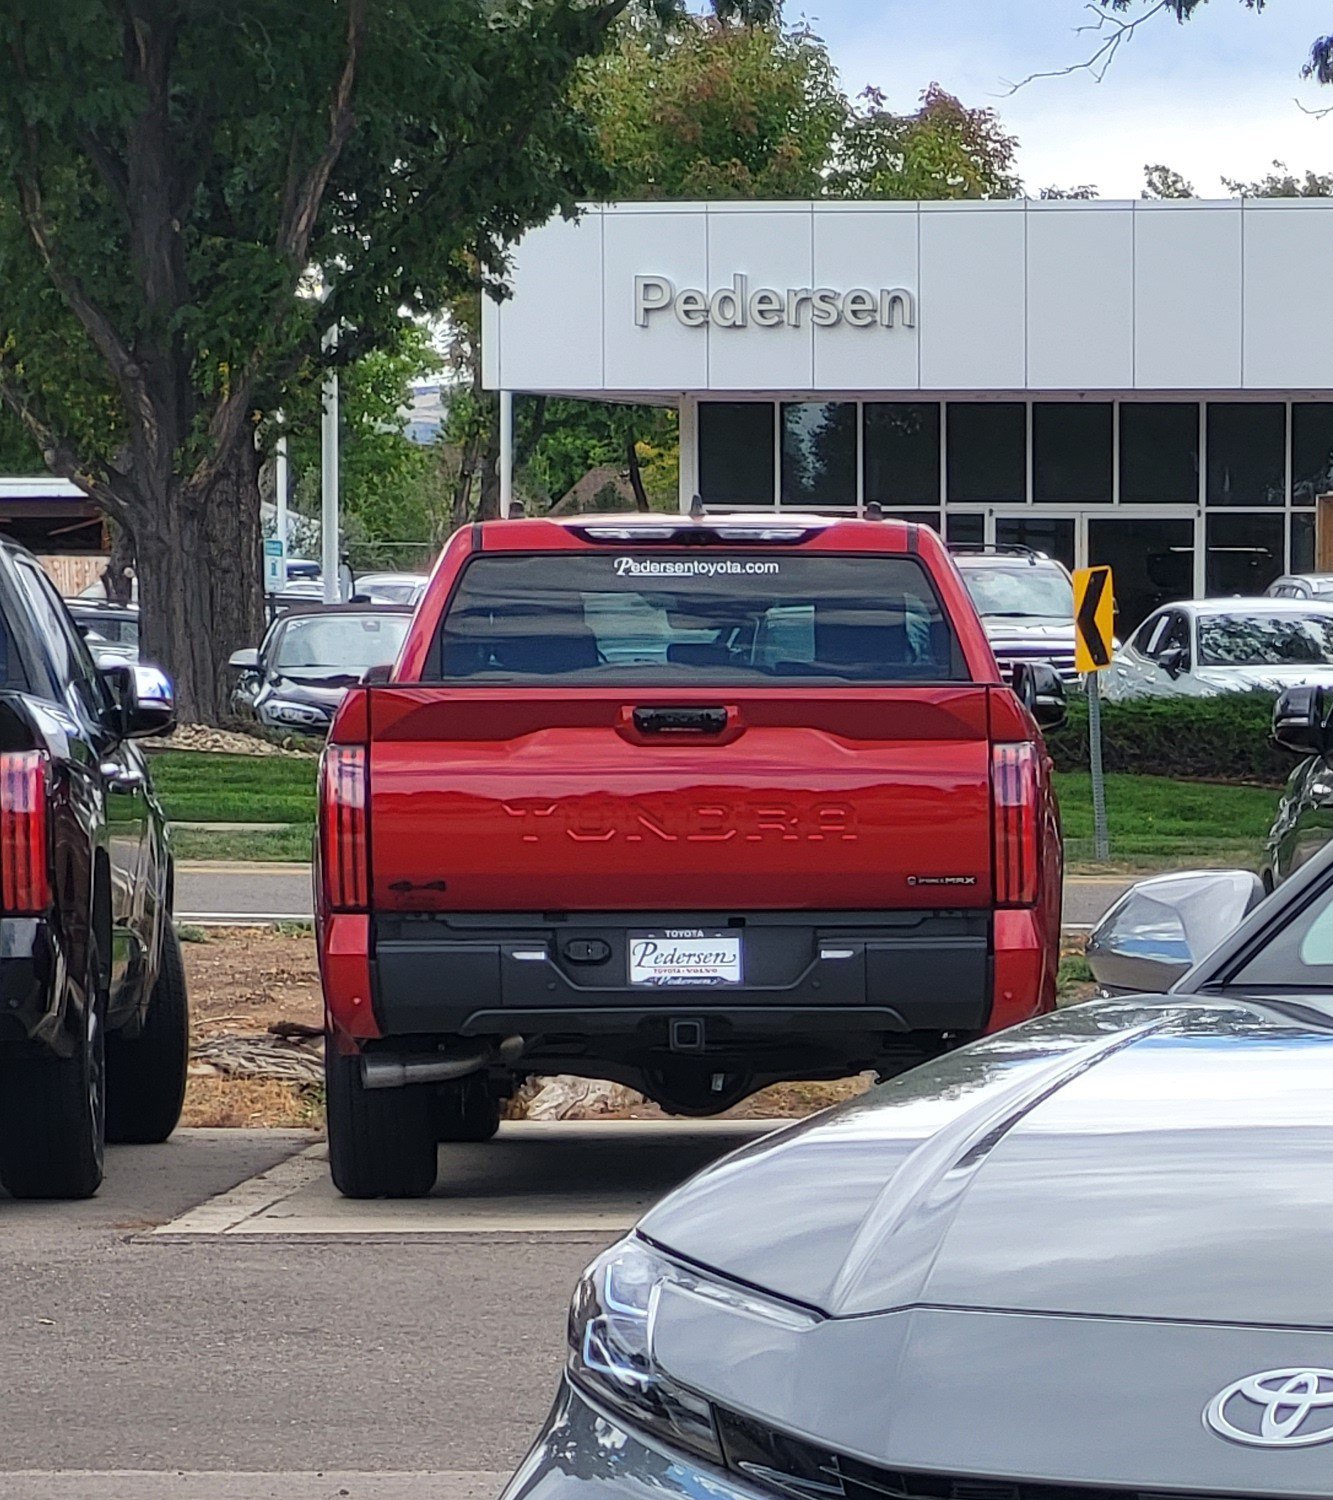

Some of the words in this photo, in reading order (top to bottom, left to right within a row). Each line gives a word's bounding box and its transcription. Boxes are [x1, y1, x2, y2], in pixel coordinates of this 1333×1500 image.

[634, 273, 916, 328] Pedersen
[614, 557, 779, 576] Pedersentoyota.com
[501, 801, 858, 841] TUNDRA
[664, 930, 705, 938] TOYOTA
[632, 941, 737, 968] Pedersen
